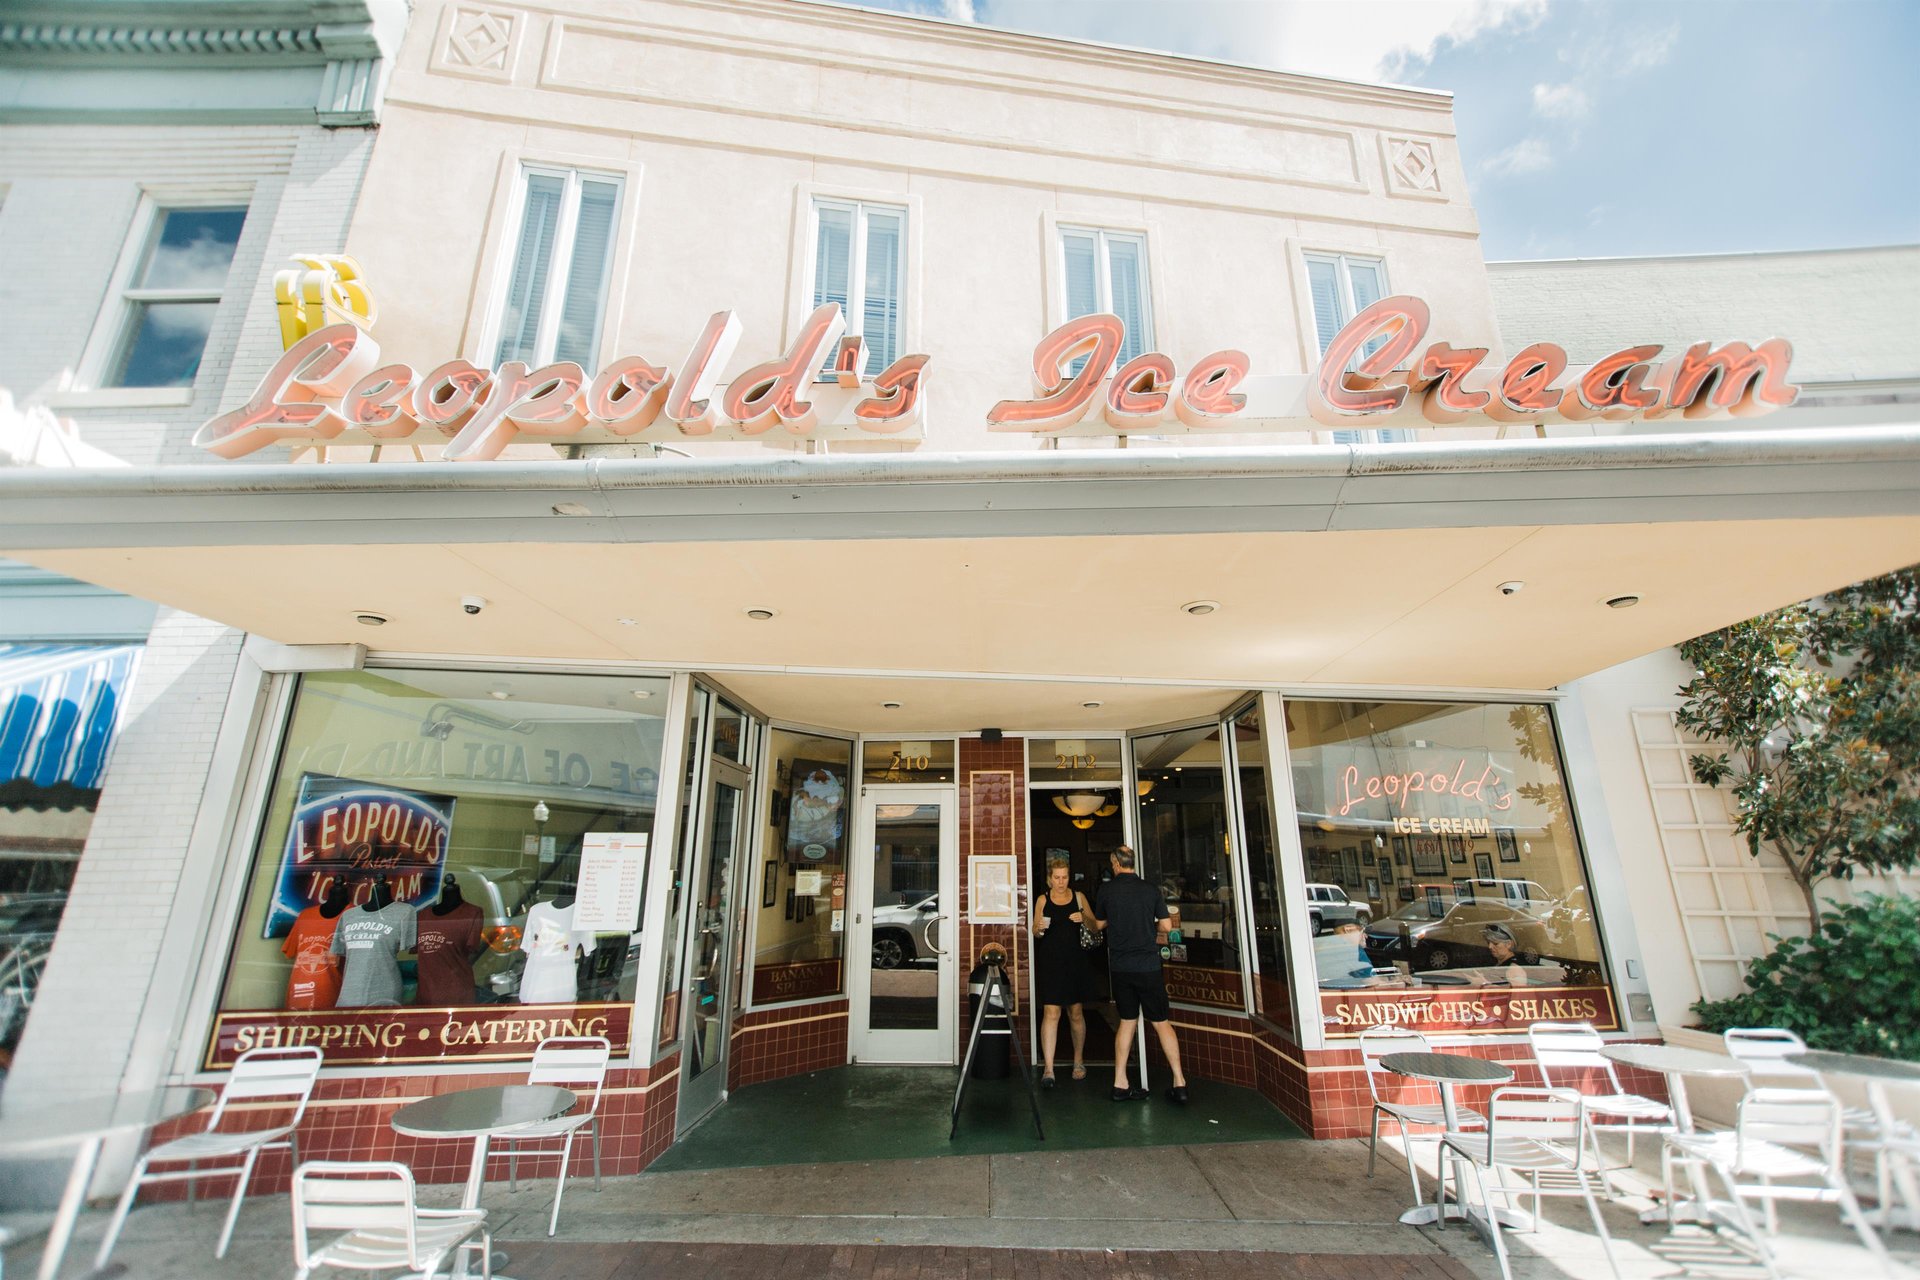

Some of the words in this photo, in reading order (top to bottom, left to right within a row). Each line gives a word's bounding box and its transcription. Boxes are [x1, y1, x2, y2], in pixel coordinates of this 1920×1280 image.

[192, 302, 933, 461] Leopold's
[986, 311, 1250, 433] Ice
[1307, 295, 1801, 427] Cream
[889, 754, 930, 771] 210
[1055, 753, 1097, 770] 212
[1339, 759, 1512, 816] Leopold's
[296, 802, 447, 864] LEOPOLD'S
[1393, 817, 1422, 834] ICE
[1428, 817, 1491, 834] CREAM
[307, 871, 347, 904] IC
[770, 967, 824, 982] BANANA
[1172, 969, 1216, 985] SODA
[1165, 983, 1238, 1003] OUNTAIN
[1335, 1000, 1488, 1026] SANDWICHES
[1509, 999, 1598, 1021] SHAKES
[233, 1022, 406, 1053] SHIPPING
[440, 1017, 608, 1046] CATERING
